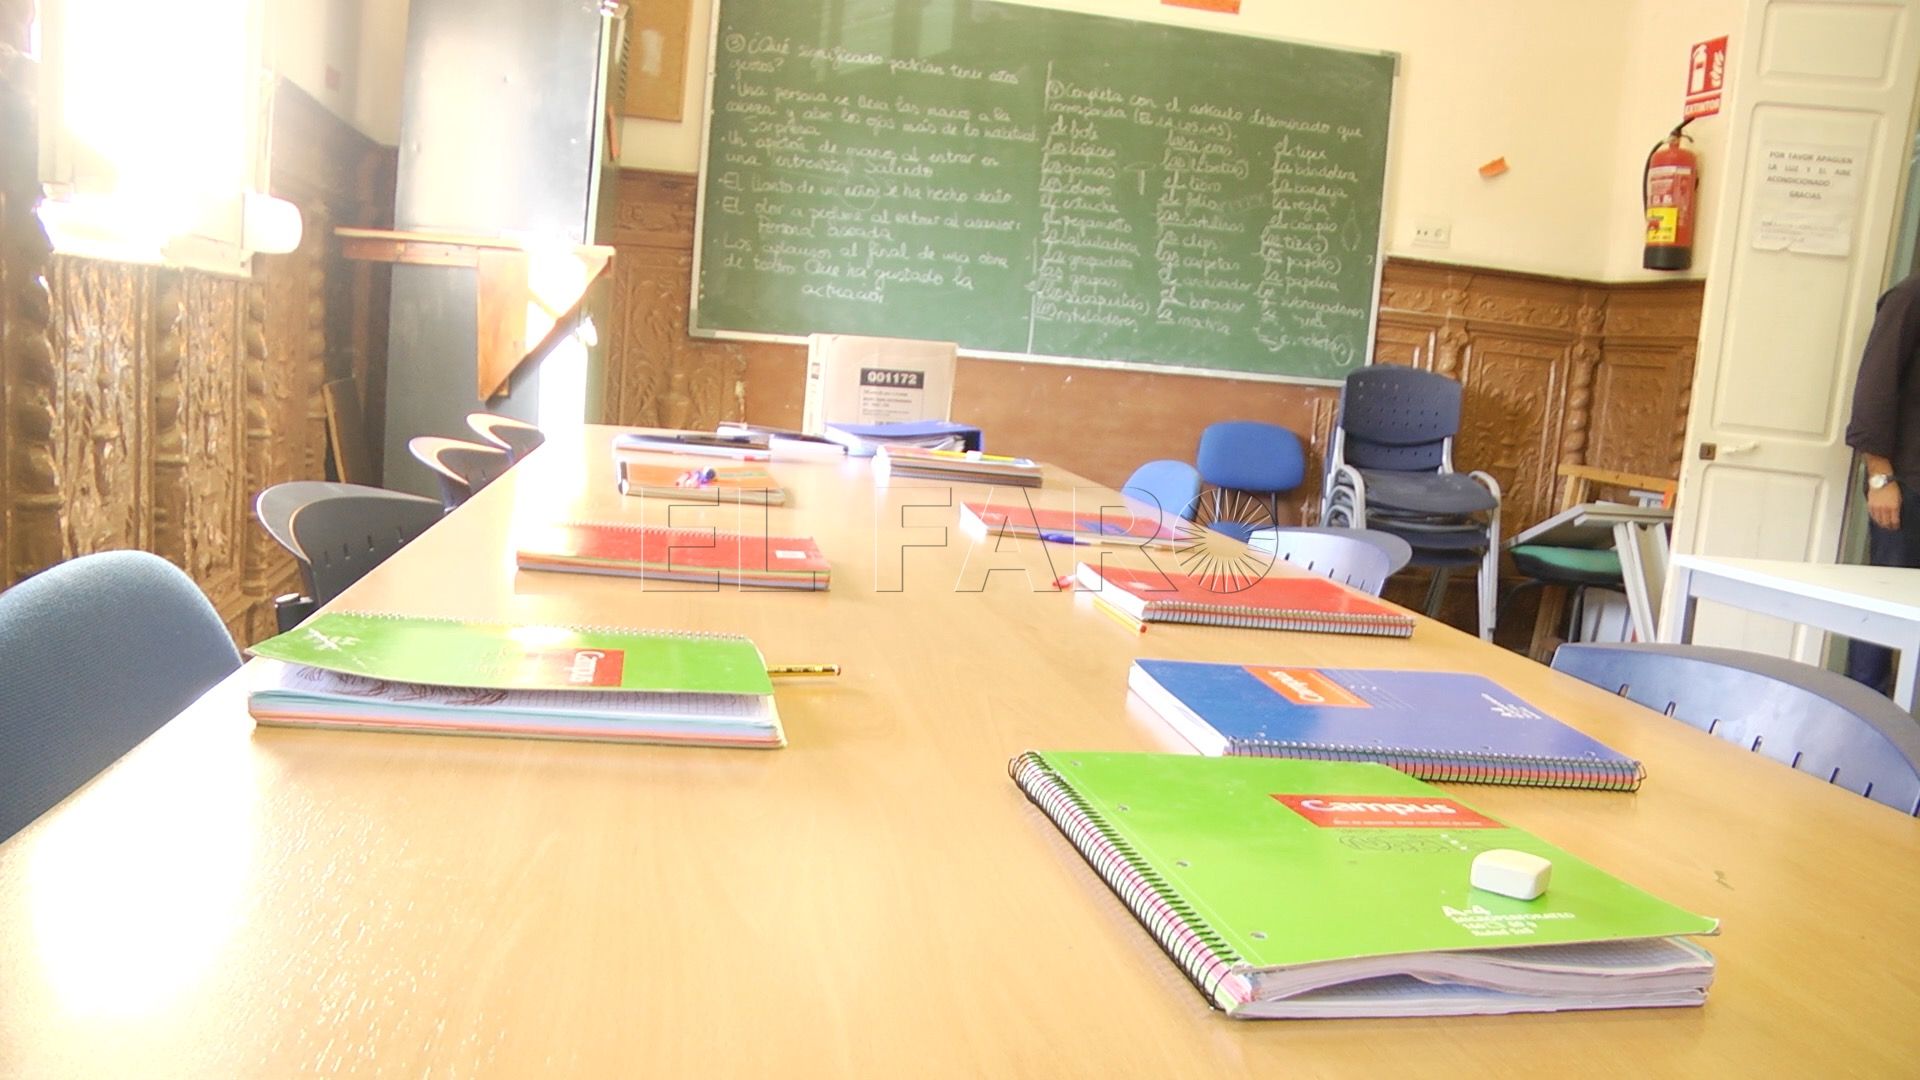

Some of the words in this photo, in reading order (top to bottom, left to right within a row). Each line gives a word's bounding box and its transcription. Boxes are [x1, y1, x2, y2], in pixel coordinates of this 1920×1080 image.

[774, 86, 828, 104] persona
[895, 95, 920, 115] las
[978, 112, 992, 122] a
[993, 106, 1011, 122] la
[1129, 94, 1157, 109] con
[1165, 96, 1181, 113] el
[1337, 124, 1364, 143] que
[942, 122, 957, 136] de
[726, 152, 762, 166] una
[901, 145, 920, 163] al
[928, 149, 976, 164] entrar
[981, 155, 1000, 167] en
[1769, 150, 1785, 159] POR
[1788, 151, 1814, 161] FAVOR
[1815, 154, 1853, 165] APAGUEN
[1767, 163, 1777, 171] LA
[1784, 163, 1799, 173] LUZ
[1766, 175, 1832, 187] ACONDICIONADO
[903, 182, 921, 199] ha
[926, 184, 969, 203] hecho
[1788, 190, 1823, 200] GRACIAS
[839, 241, 858, 257] al
[917, 244, 936, 261] de
[942, 251, 971, 264] una
[951, 265, 975, 291] la
[867, 370, 918, 386] 001172
[1300, 798, 1457, 816] Campus
[1440, 904, 1491, 917] A-4
